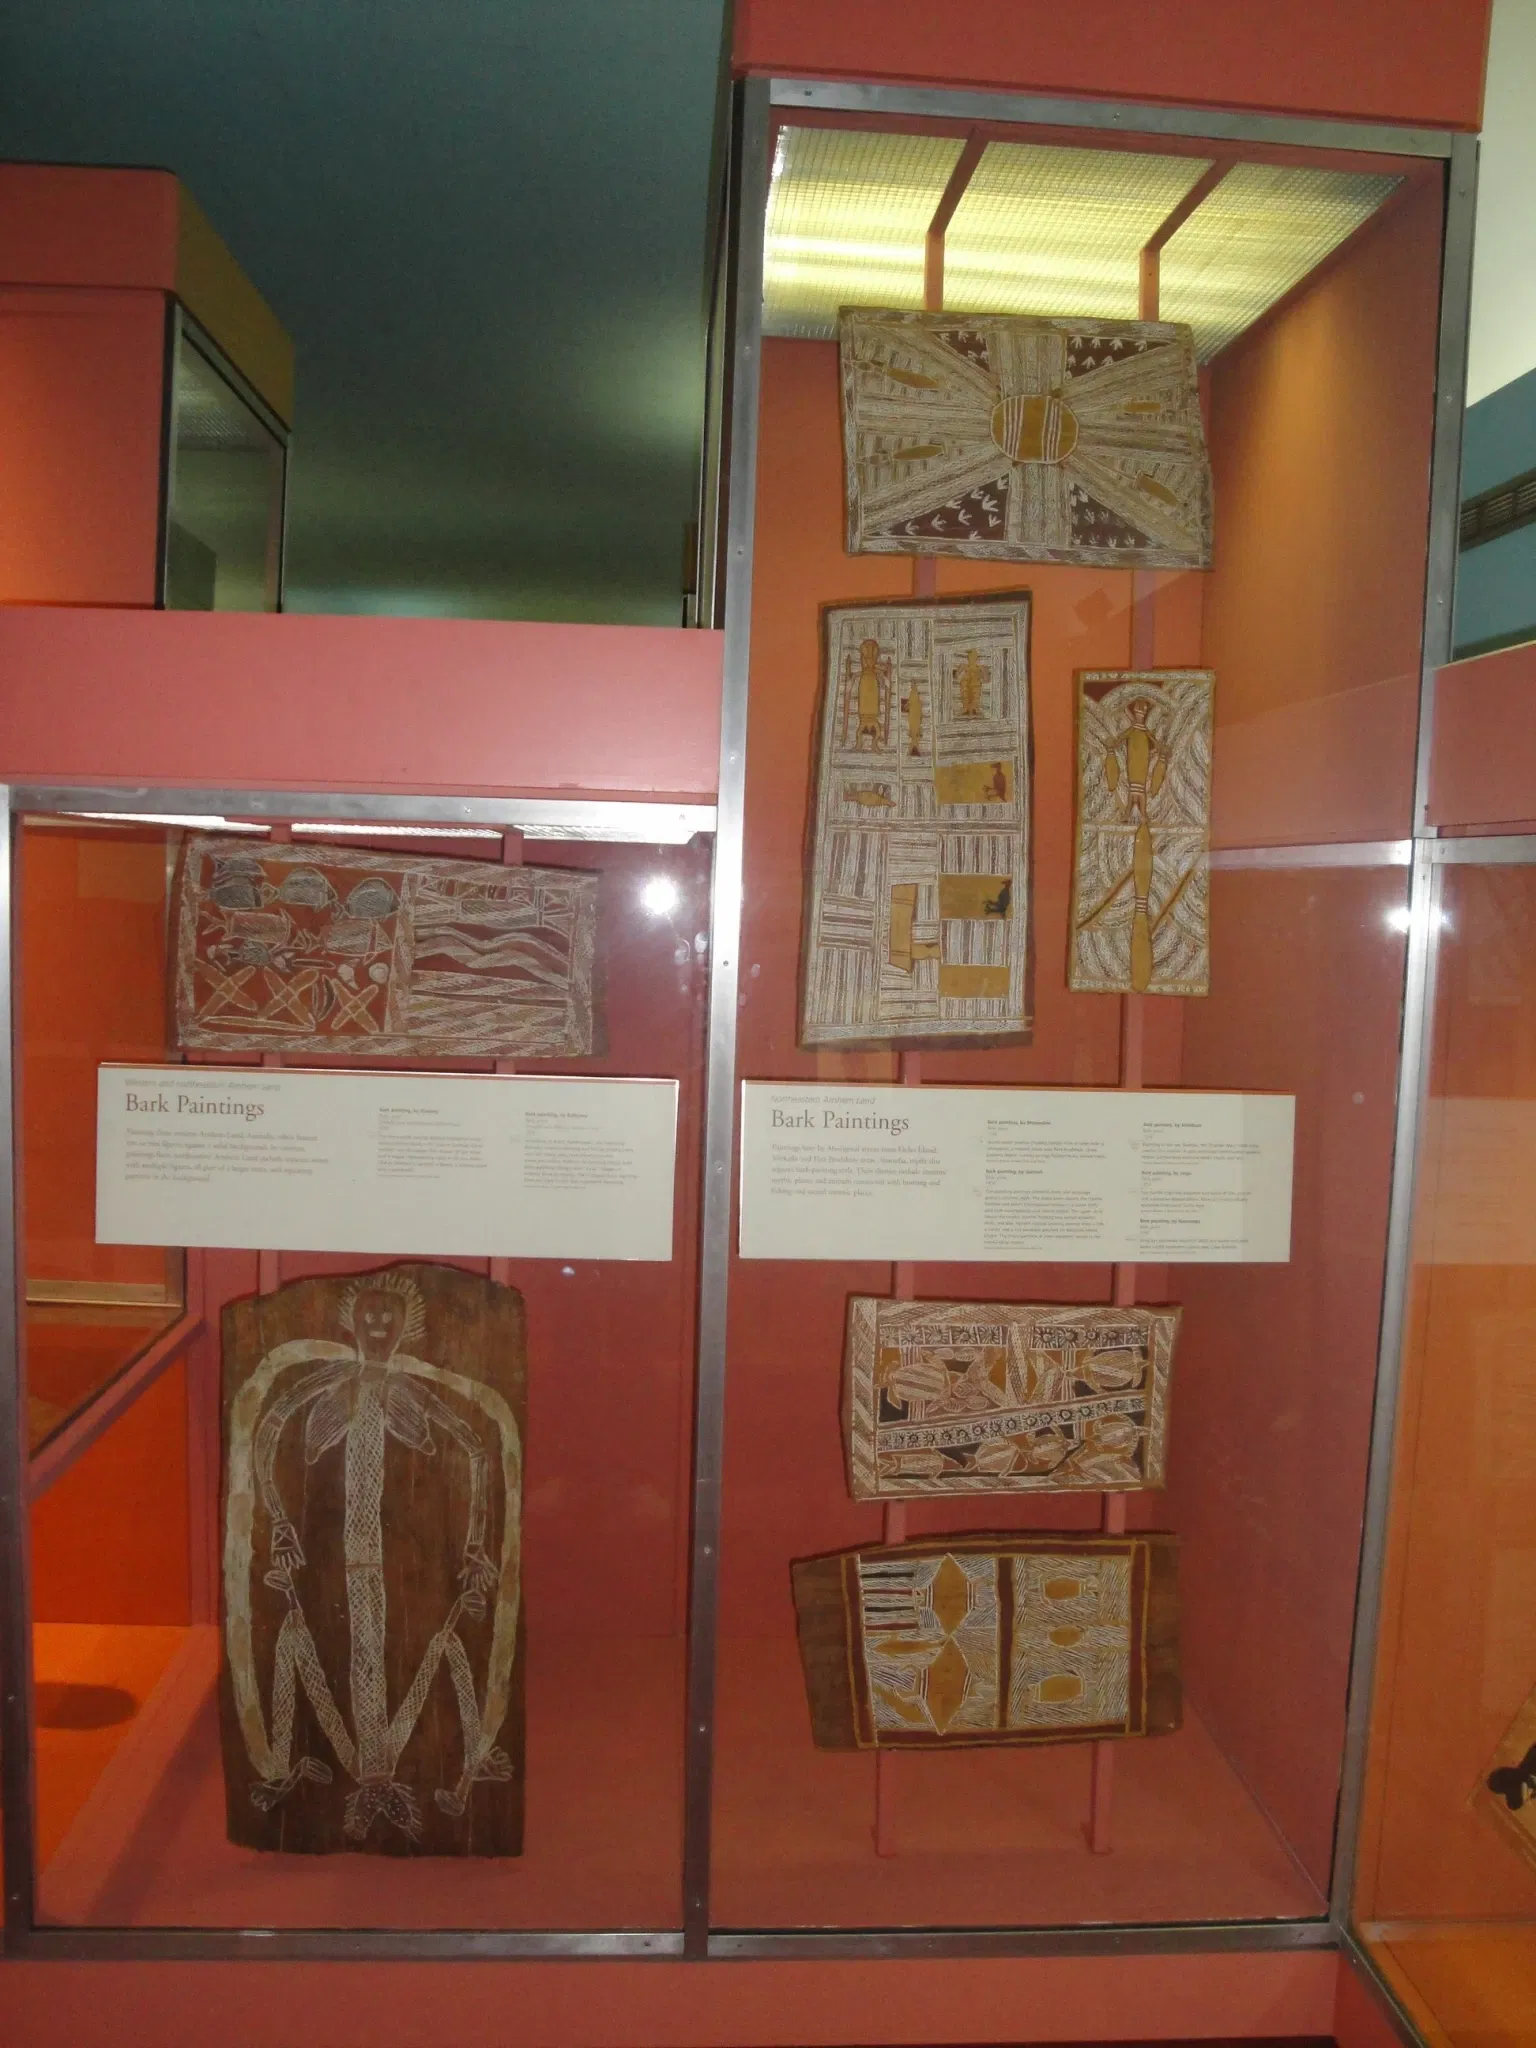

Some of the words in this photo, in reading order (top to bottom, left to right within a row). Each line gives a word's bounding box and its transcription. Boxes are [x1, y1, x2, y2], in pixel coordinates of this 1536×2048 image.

[125, 1093, 170, 1112] Bark
[177, 1094, 264, 1121] Paintings
[772, 1109, 816, 1128] Bark
[823, 1110, 909, 1136] Paintings
